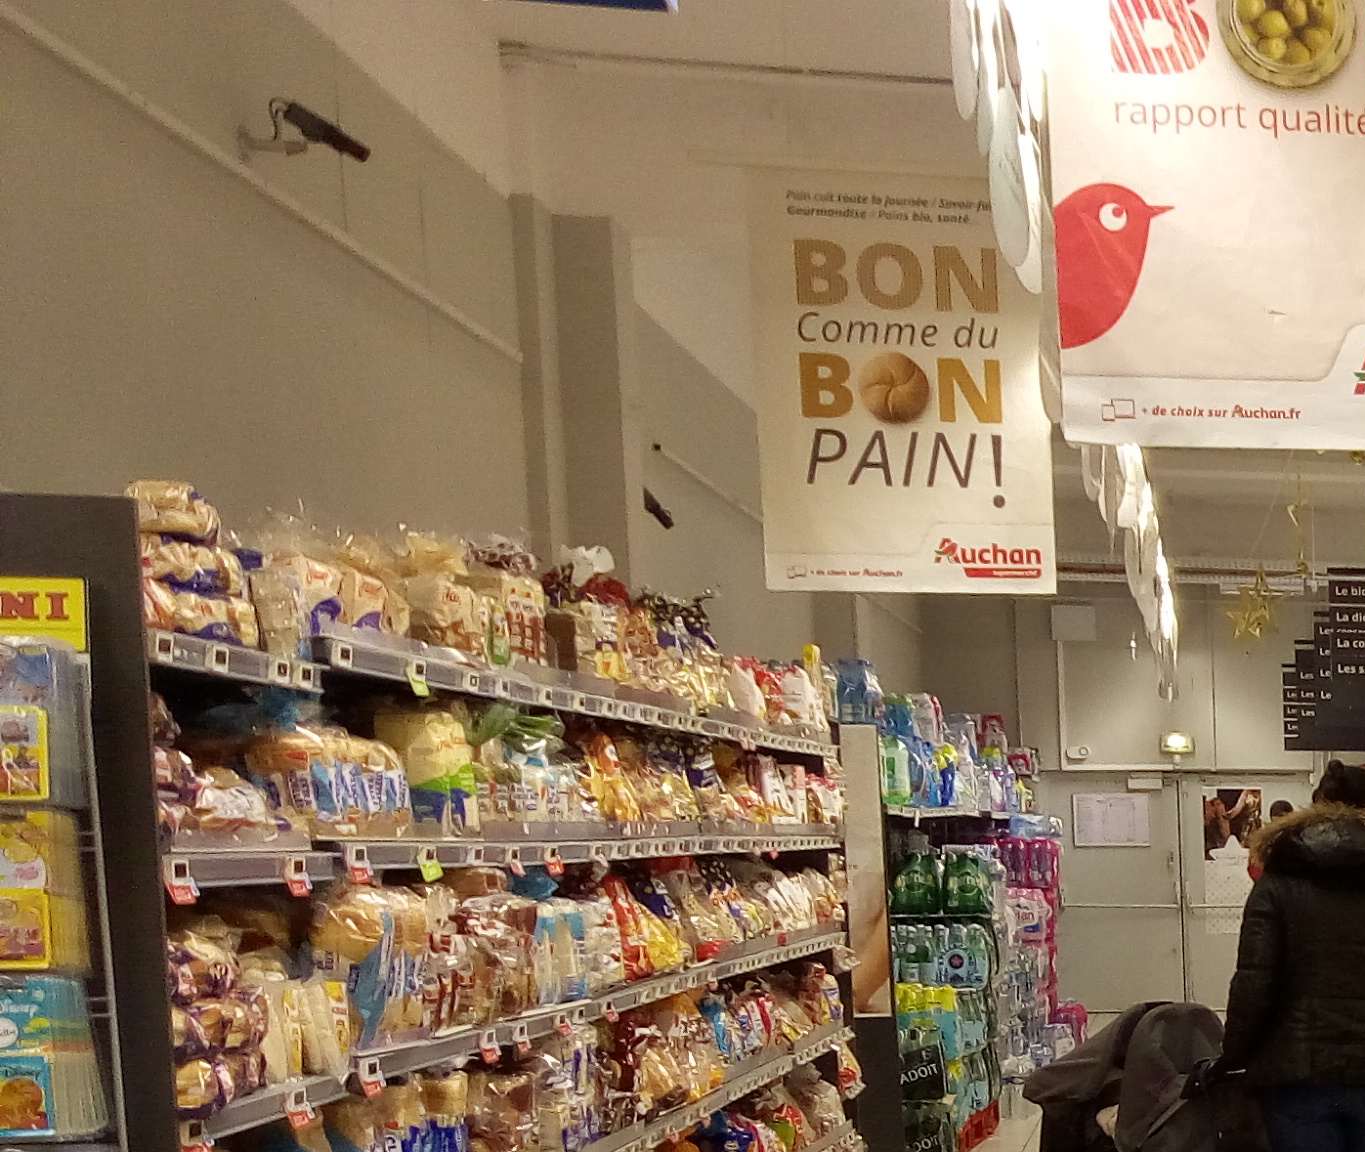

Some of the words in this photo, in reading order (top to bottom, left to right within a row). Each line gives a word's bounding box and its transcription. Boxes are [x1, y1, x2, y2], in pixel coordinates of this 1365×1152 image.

[1113, 101, 1246, 135] rapport
[793, 239, 999, 314] BON
[797, 311, 939, 347] Comme
[953, 317, 999, 350] du
[1151, 405, 1168, 418] de
[1170, 406, 1205, 418] choix
[1207, 408, 1229, 419] sur
[1231, 404, 1302, 420] Auchan.fr
[934, 537, 1042, 565] Auchan
[1335, 585, 1349, 596] Le
[1336, 612, 1350, 622] La
[1336, 638, 1350, 648] La
[1337, 663, 1356, 674] Les
